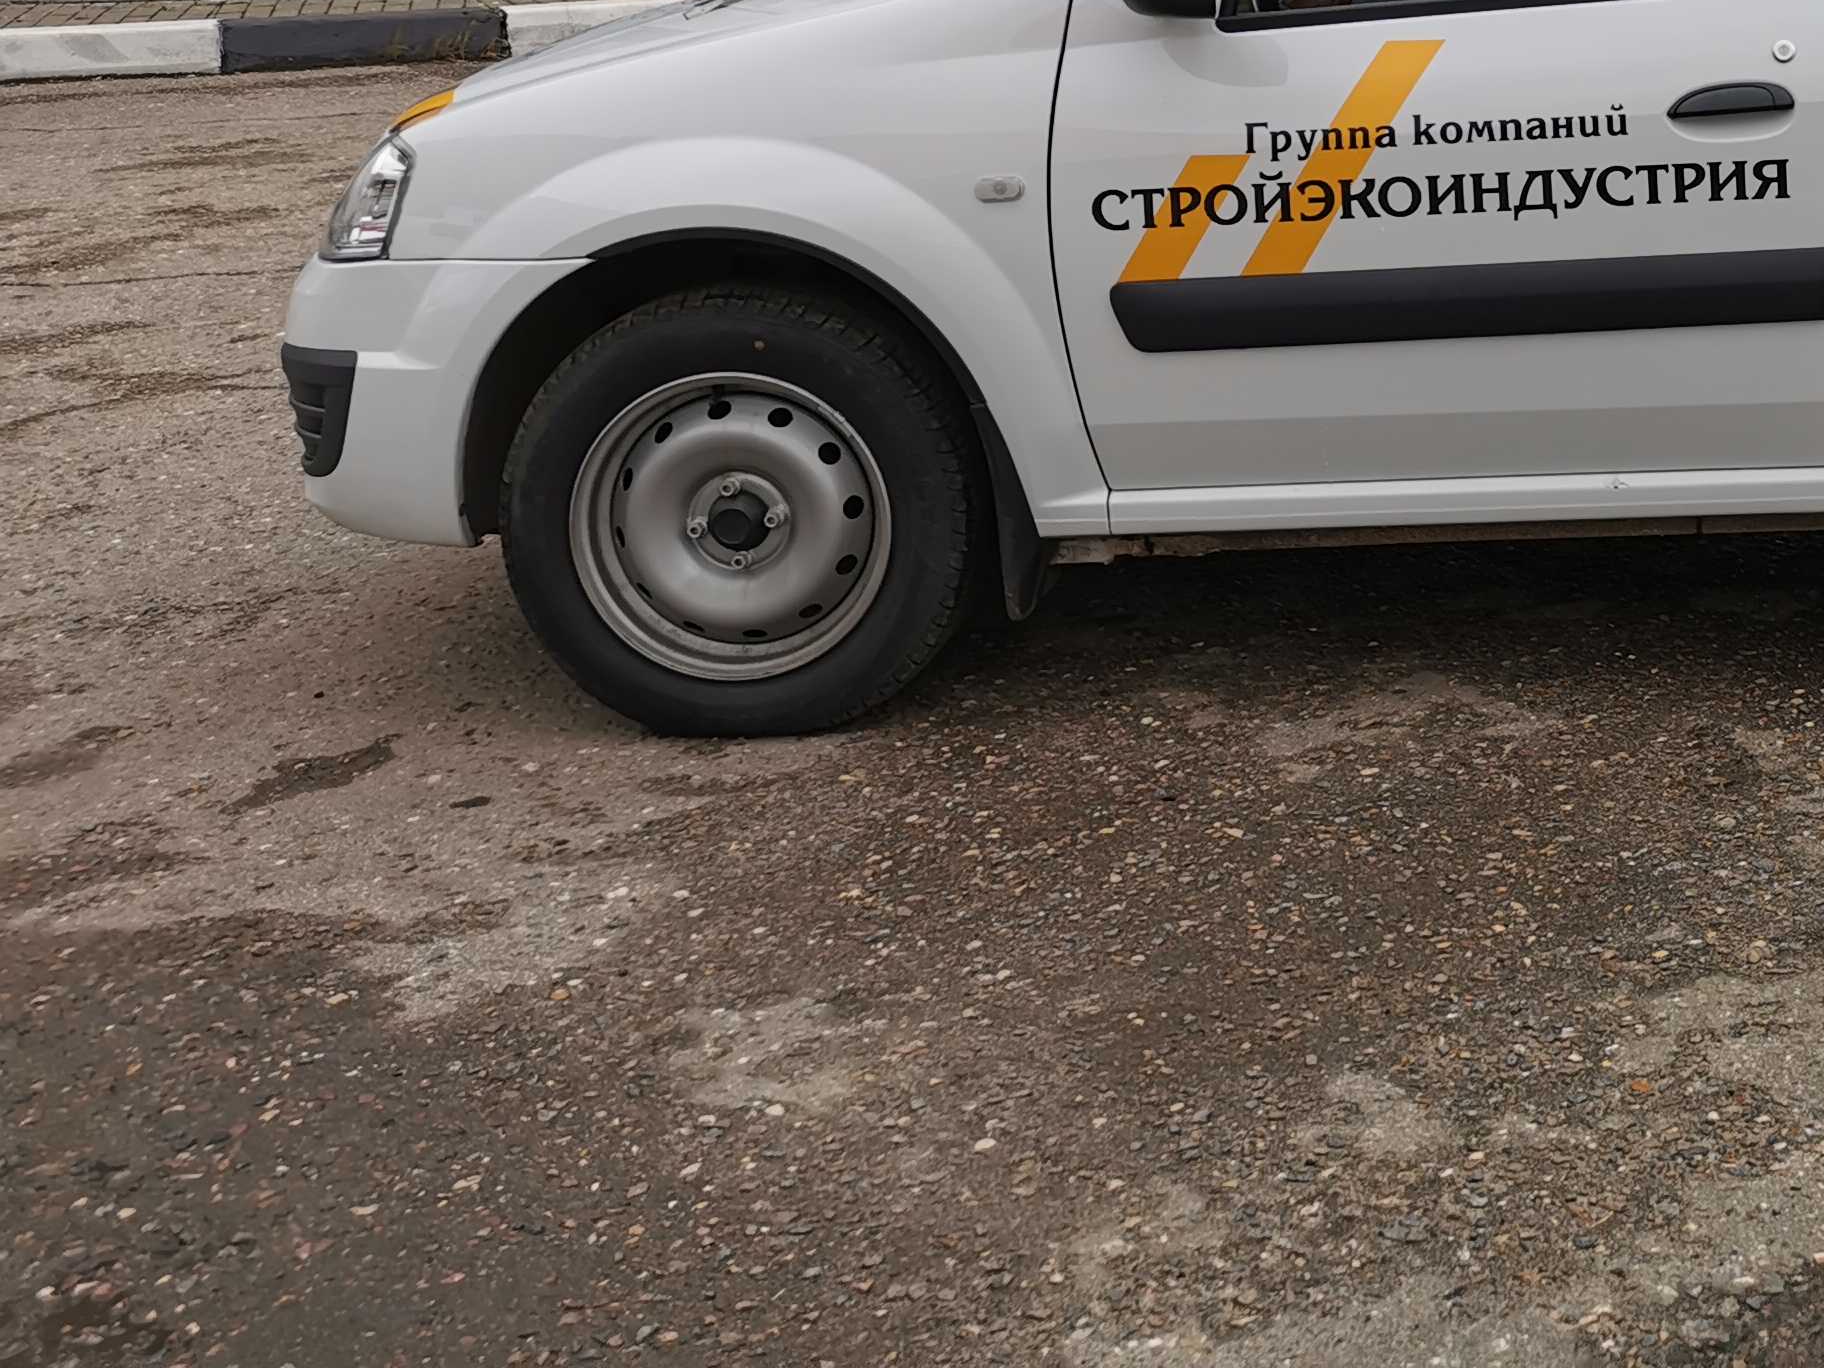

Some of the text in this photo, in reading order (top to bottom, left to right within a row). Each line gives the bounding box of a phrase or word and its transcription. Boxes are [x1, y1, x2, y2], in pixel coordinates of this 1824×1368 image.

[1244, 104, 1630, 163] Группа компаний
[1091, 158, 1791, 232] СТРОЙЭКОИНДУСТРИЯ
